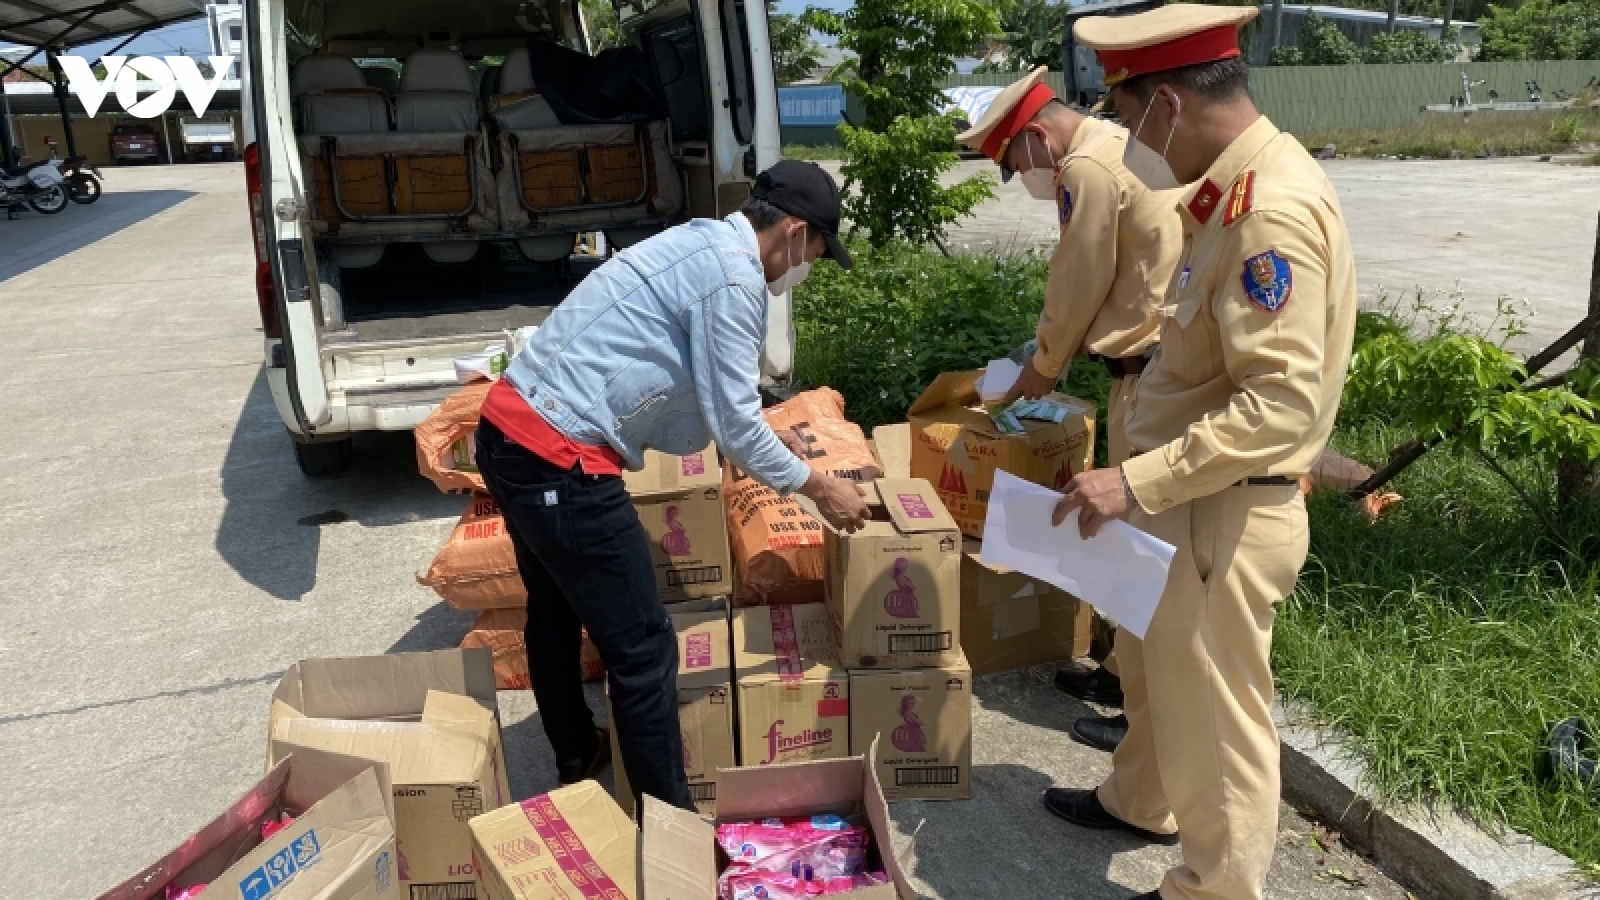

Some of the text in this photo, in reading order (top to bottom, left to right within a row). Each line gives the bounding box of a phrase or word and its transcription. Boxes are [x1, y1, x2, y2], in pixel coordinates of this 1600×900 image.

[475, 501, 500, 517] USE
[463, 521, 499, 541] MADE
[770, 521, 821, 532] USE NO
[760, 719, 833, 765] fineline
[394, 788, 427, 798] sion
[447, 863, 474, 877] LIO
